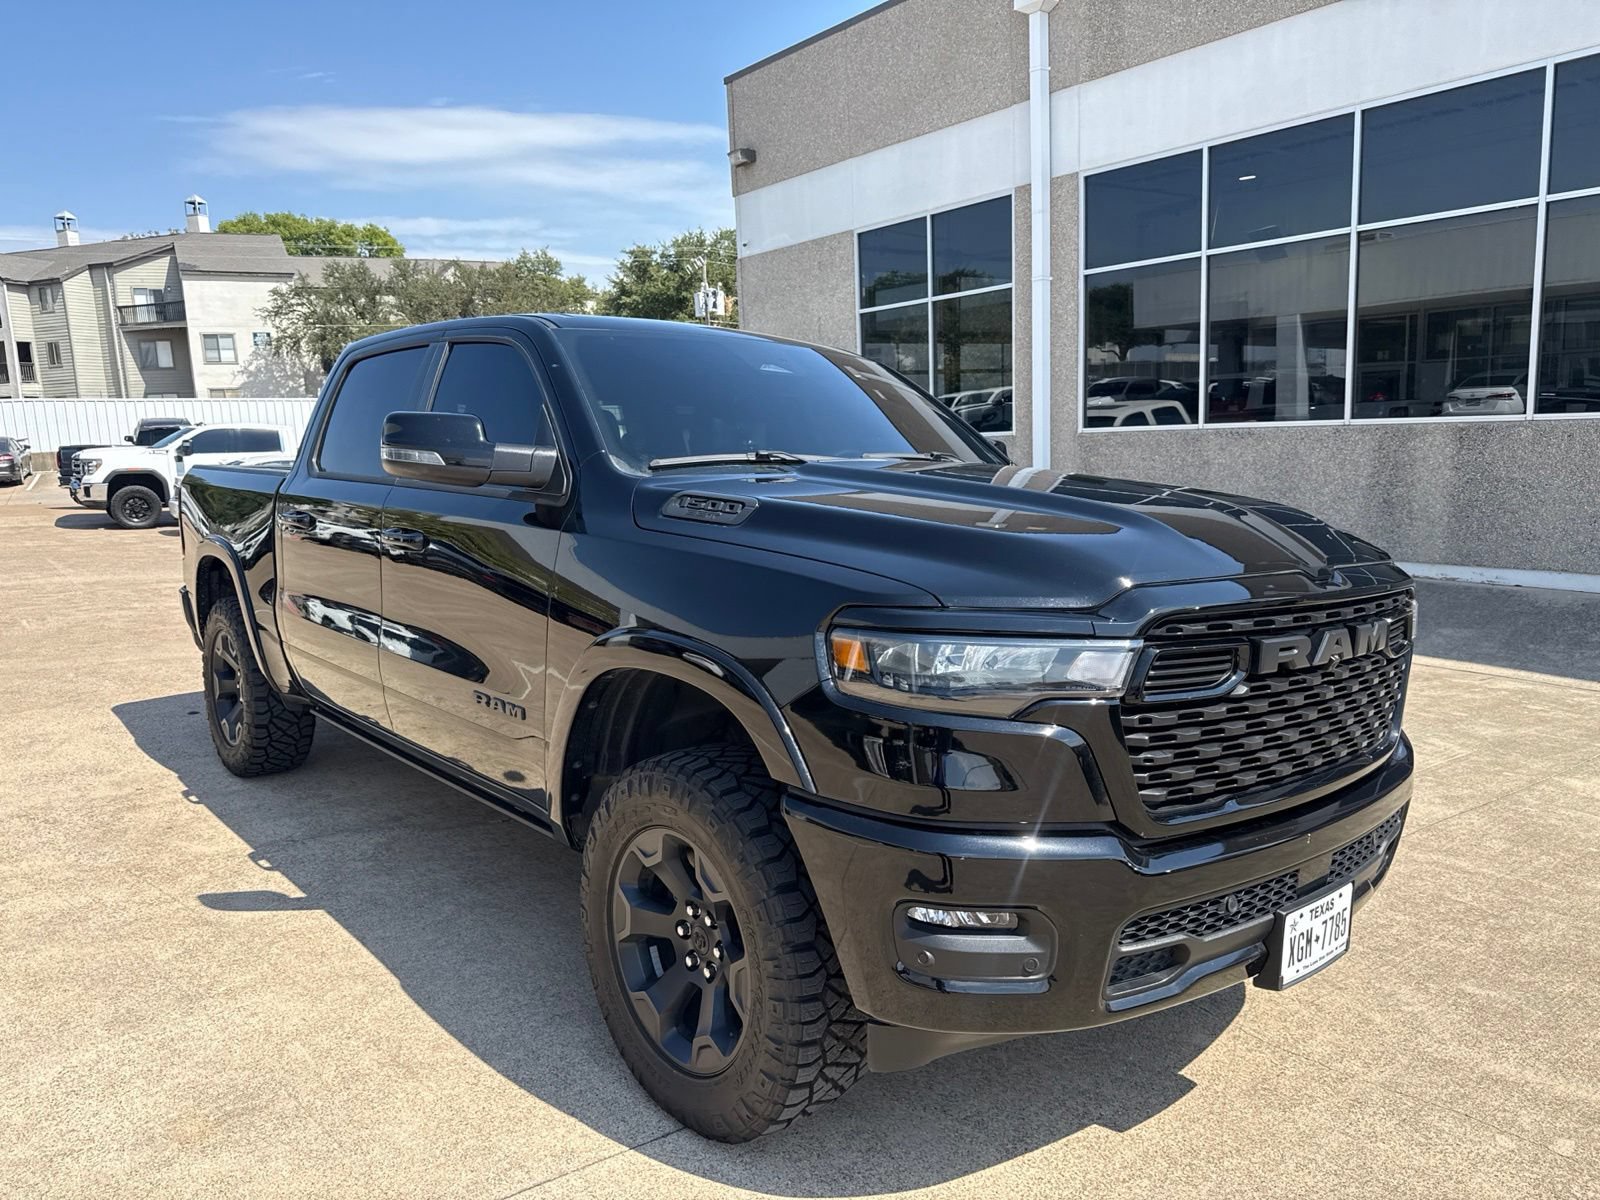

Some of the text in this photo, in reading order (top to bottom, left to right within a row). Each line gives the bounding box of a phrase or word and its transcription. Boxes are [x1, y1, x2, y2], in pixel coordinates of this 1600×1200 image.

[679, 495, 743, 514] 1500
[1258, 619, 1389, 674] RAM
[473, 690, 527, 720] RAM
[1310, 898, 1335, 921] TEXAS
